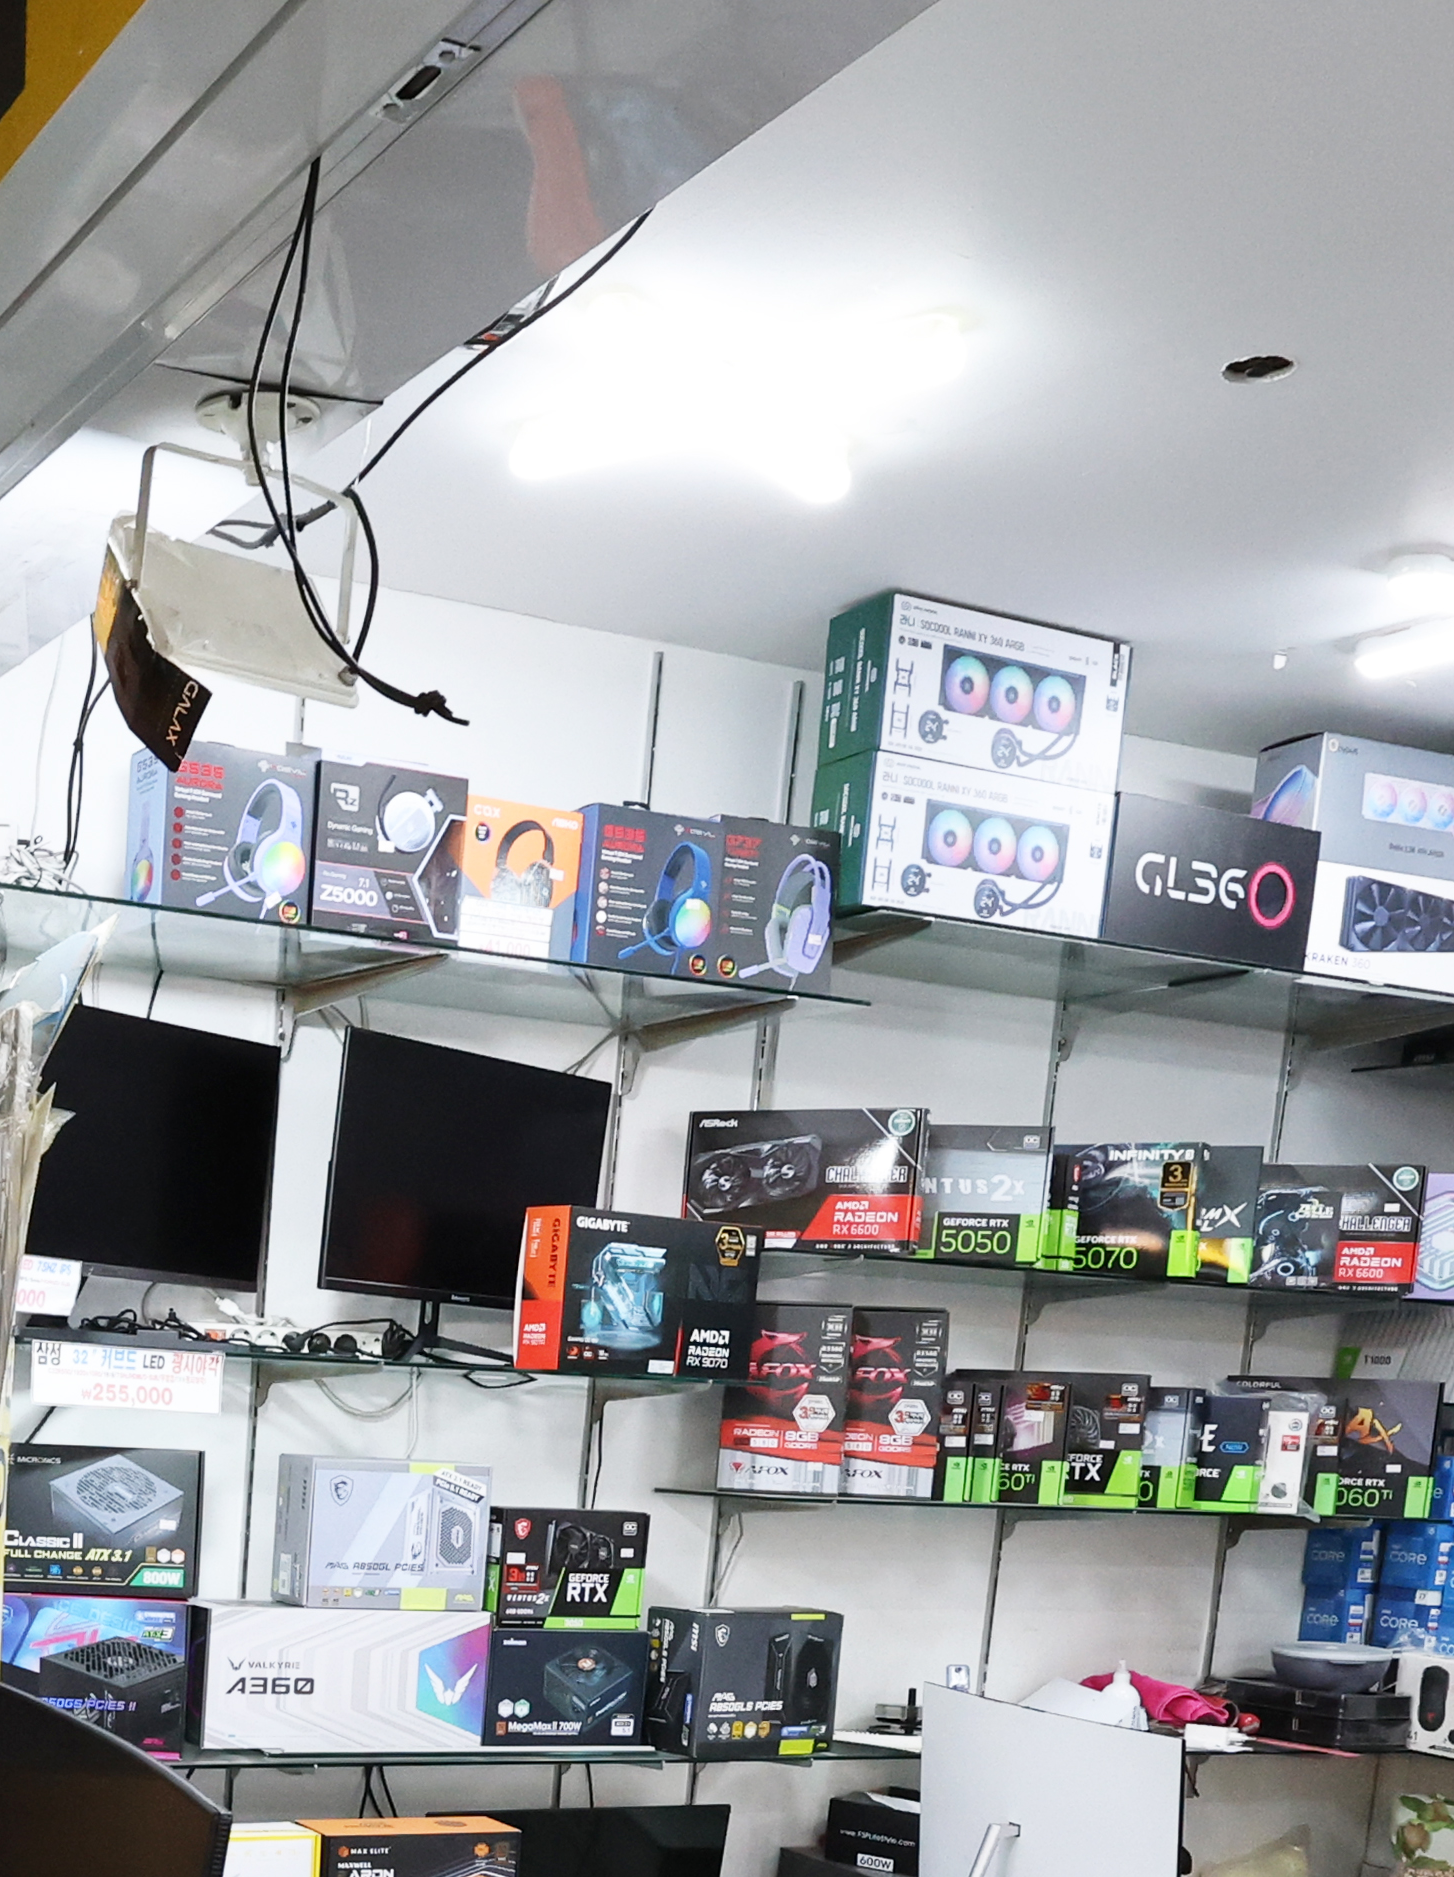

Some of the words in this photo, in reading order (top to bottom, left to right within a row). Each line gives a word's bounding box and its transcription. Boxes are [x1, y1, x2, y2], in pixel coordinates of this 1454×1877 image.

[165, 679, 201, 750] GALAX
[320, 884, 378, 907] Z5000
[576, 1216, 630, 1233] GIGABYTE
[834, 1211, 898, 1224] RADEON
[943, 1217, 989, 1230] GEFORCE
[991, 1217, 1009, 1228] RTX
[833, 1223, 849, 1235] RX
[851, 1224, 880, 1236] 6600
[941, 1230, 1011, 1254] 5050
[547, 1218, 562, 1288] GIGABYTE
[1073, 1246, 1138, 1270] 5070
[1340, 1256, 1402, 1268] RADEON
[690, 1330, 717, 1344] AMD
[37, 1342, 61, 1366] 삼성
[143, 1355, 165, 1369] LED
[688, 1345, 730, 1358] RADEON
[701, 1357, 728, 1369] 9070
[1236, 1380, 1282, 1389] COLORFUL
[785, 1431, 819, 1441] 8GB
[28, 1549, 83, 1561] CHANGE
[85, 1548, 110, 1562] ATX
[111, 1549, 133, 1563] 3.1
[143, 1570, 182, 1586] 800W
[568, 1573, 609, 1584] GEFORCE
[567, 1583, 608, 1603] RTX
[248, 1660, 301, 1669] VALKYRIE
[226, 1678, 314, 1695] A360
[559, 1721, 581, 1732] 700W
